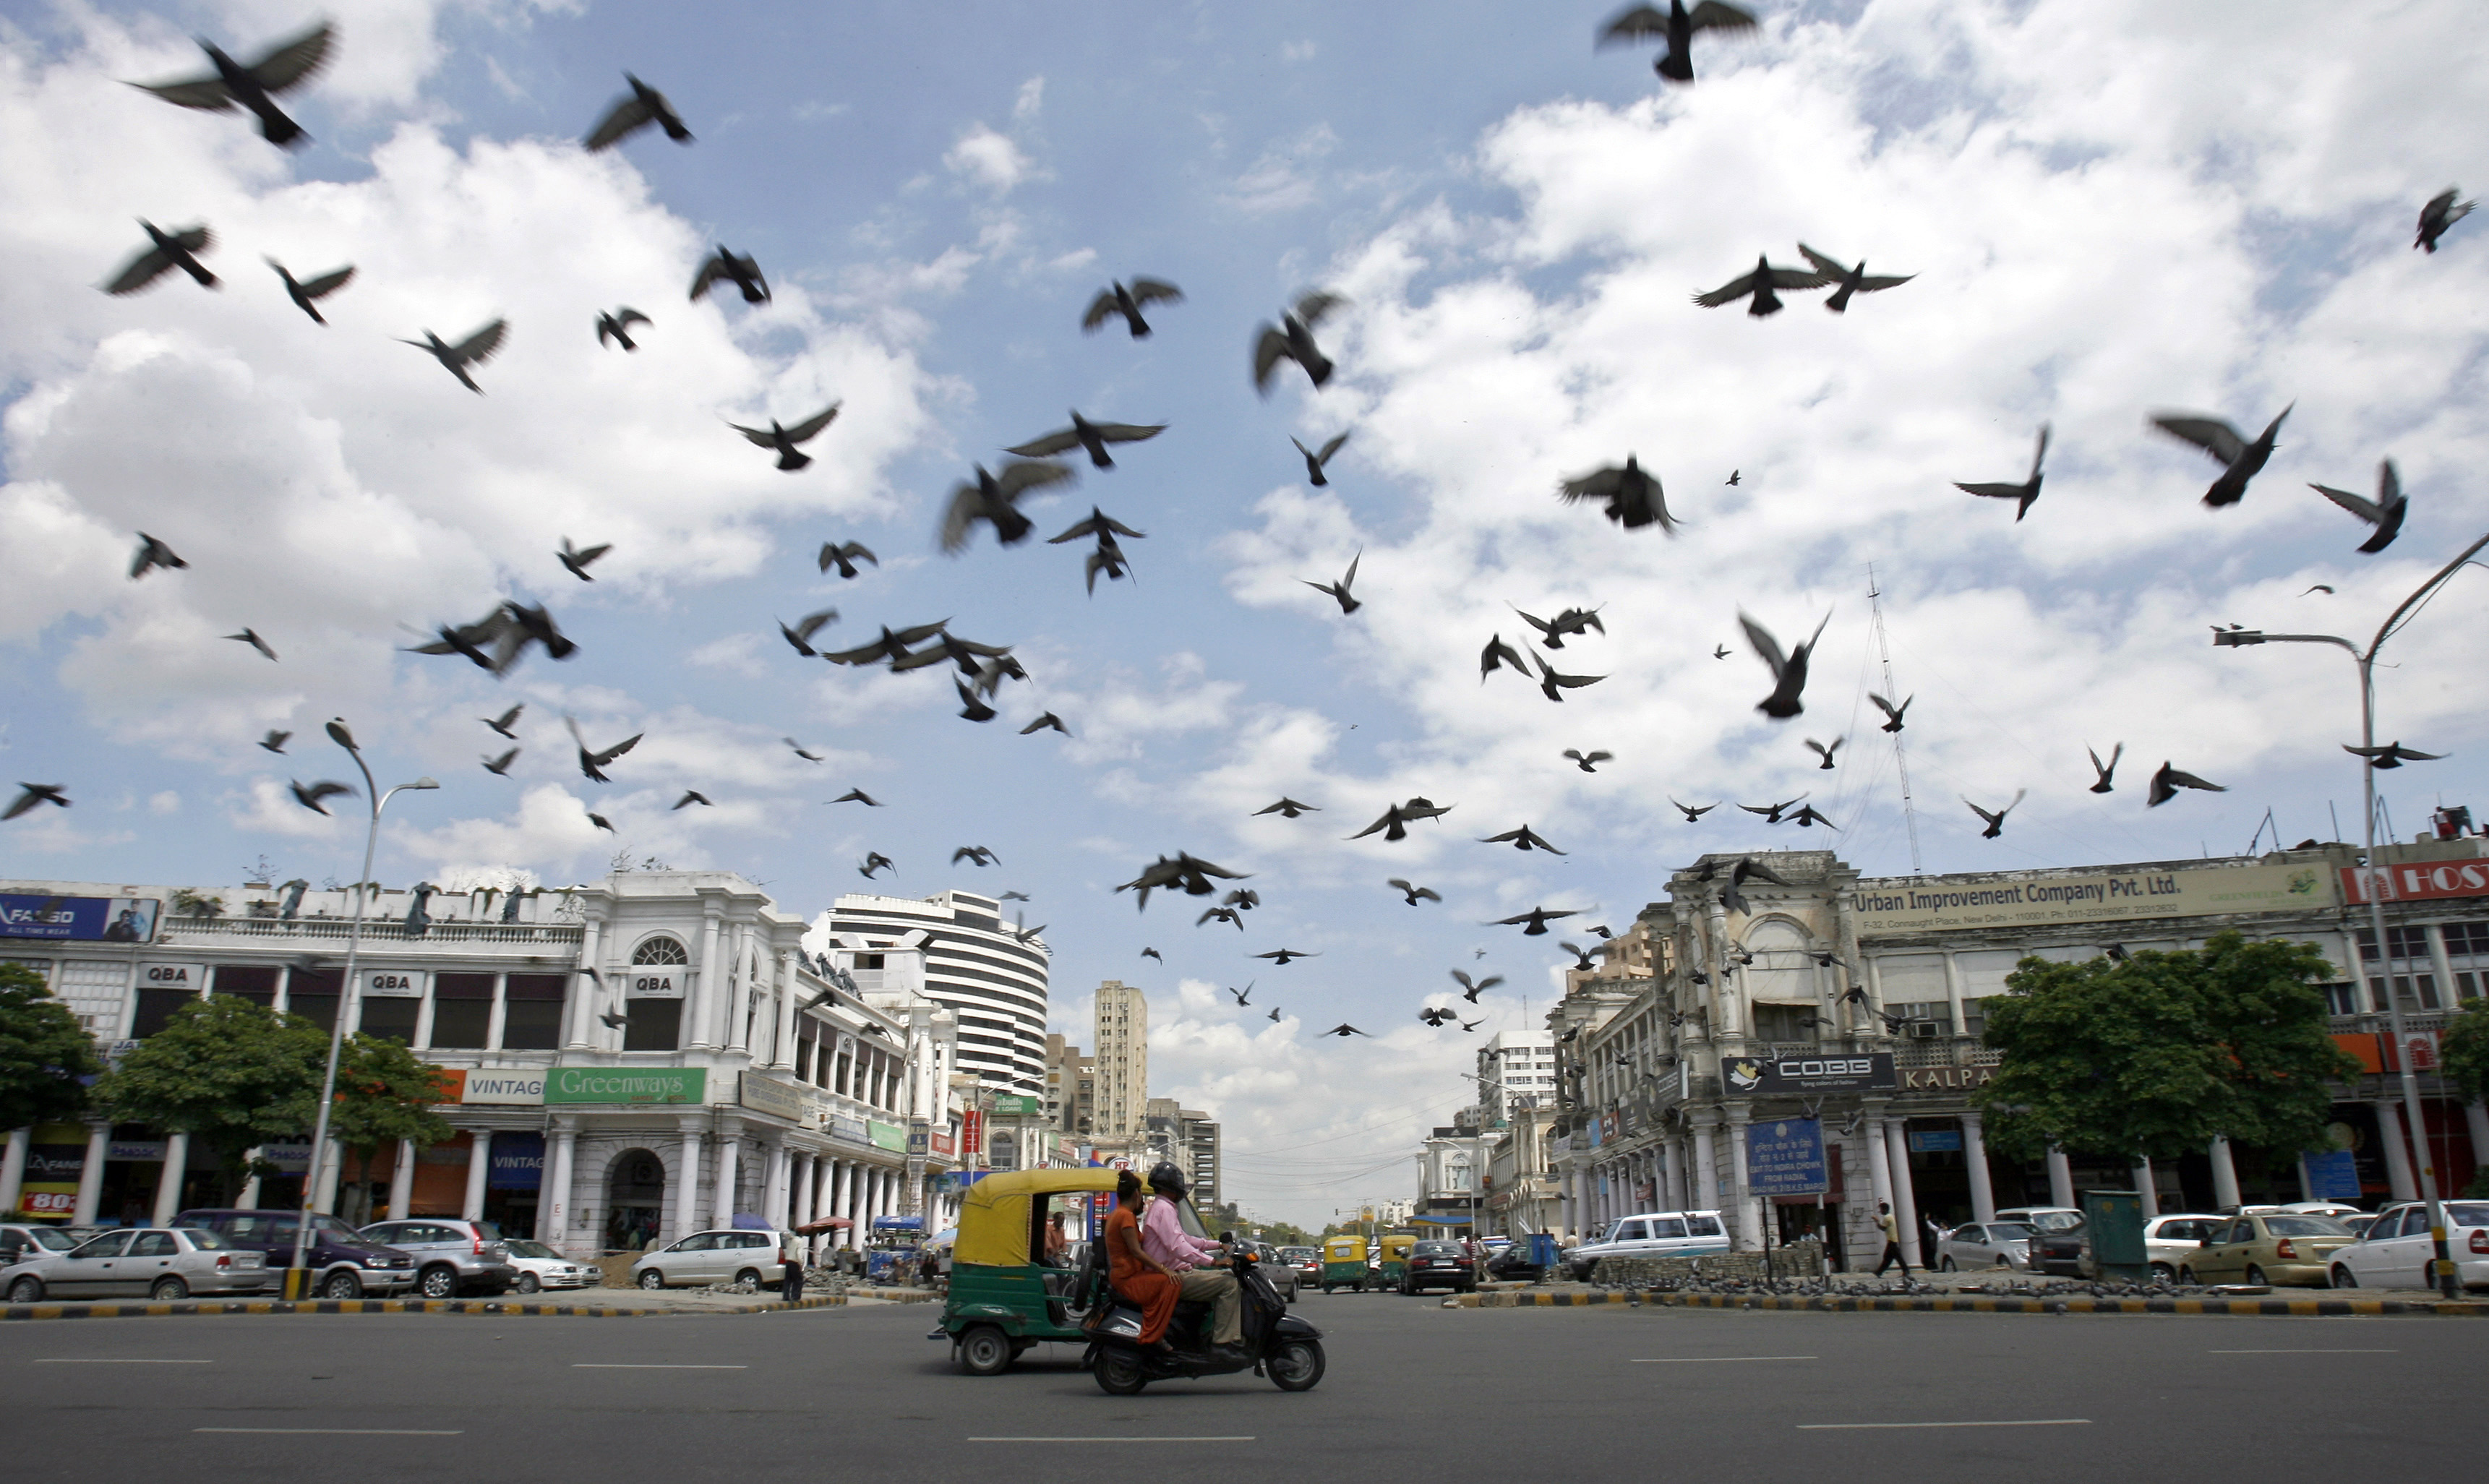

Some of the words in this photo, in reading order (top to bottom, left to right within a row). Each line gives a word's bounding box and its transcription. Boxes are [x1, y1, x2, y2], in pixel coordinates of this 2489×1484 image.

[1855, 893, 1904, 912] Urban
[1908, 885, 2023, 912] Improvement
[2026, 883, 2104, 904] Company
[2109, 878, 2143, 897] Pvt.
[2146, 875, 2182, 895] Ltd.
[1888, 919, 1933, 928] Connaught
[1780, 1059, 1872, 1076] COBB
[560, 1070, 683, 1101] Greenways
[1904, 1069, 1992, 1088] KALPA
[494, 1157, 544, 1169] VINTAG
